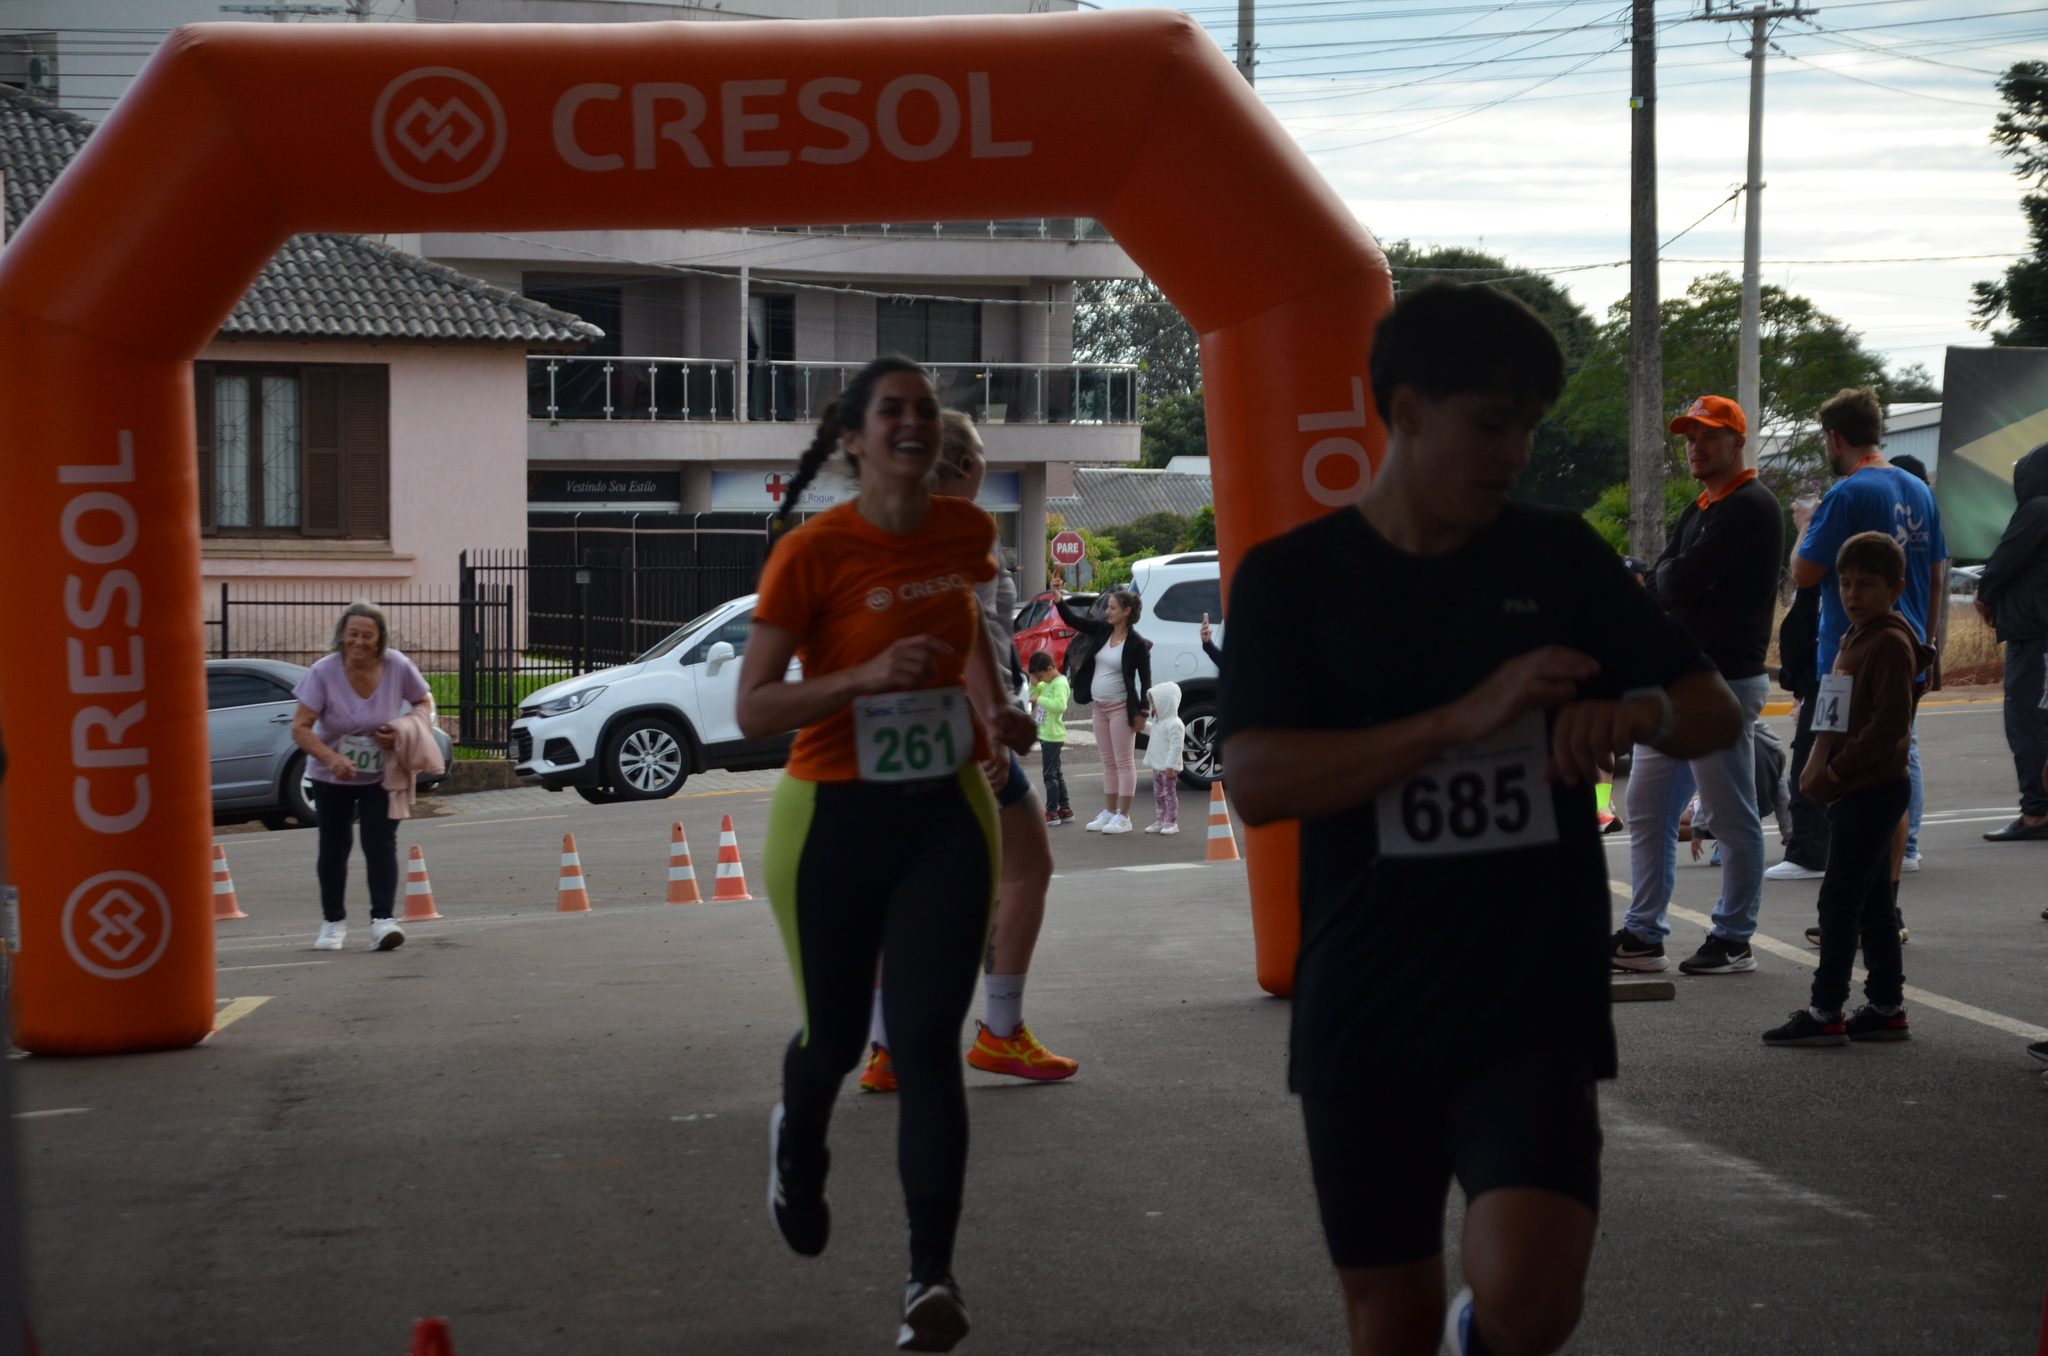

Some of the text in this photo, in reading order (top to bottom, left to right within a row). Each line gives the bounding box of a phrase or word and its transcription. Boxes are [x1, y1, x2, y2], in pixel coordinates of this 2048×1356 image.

[552, 71, 1033, 172] CRESOL
[566, 480, 656, 493] Vestindo Seu Estilo
[808, 492, 835, 504] Roque
[1056, 542, 1079, 553] PARE
[901, 573, 967, 601] CRESO
[57, 429, 151, 834] CRESOL
[345, 749, 383, 769] 101
[873, 720, 957, 773] 261
[1402, 764, 1531, 843] 685
